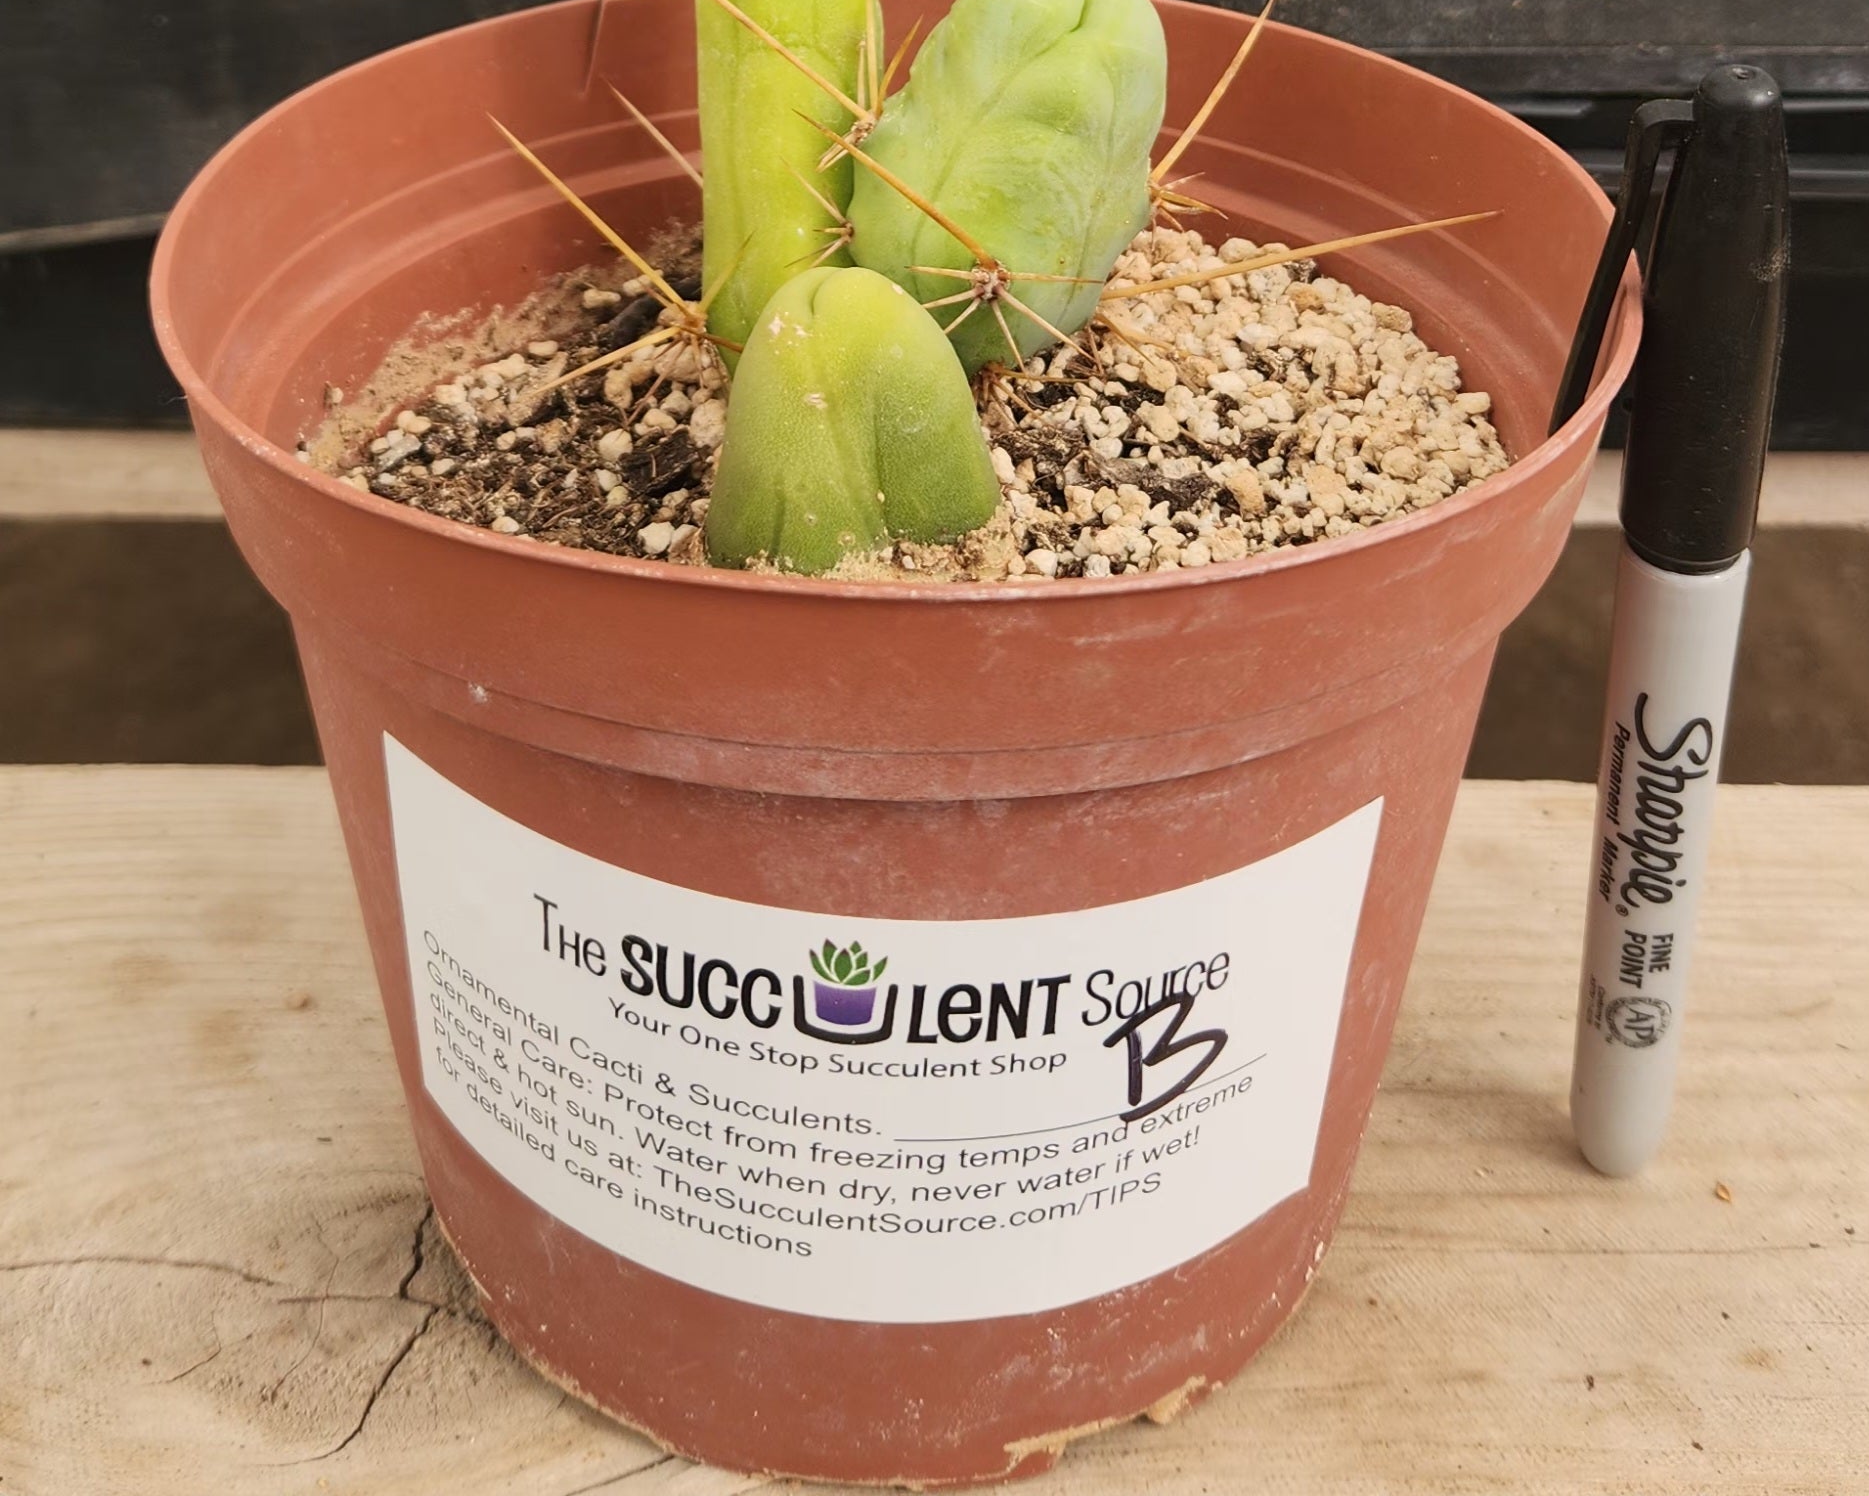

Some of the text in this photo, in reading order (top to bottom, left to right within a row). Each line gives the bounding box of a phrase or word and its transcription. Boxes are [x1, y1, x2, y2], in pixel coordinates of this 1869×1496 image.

[1598, 720, 1632, 903] Permanent Marker
[424, 930, 882, 1136] Ornamental Cacti & Succulents.
[608, 996, 1067, 1078] Your One Stop Succulent Shop
[1081, 951, 1230, 1027] Source
[1618, 929, 1648, 990] POINT
[1648, 932, 1675, 974] FINE
[427, 960, 1253, 1175] General Care: Protect from freezing temps and extreme
[430, 992, 1201, 1206] direct & hot sun. Water when dry, never water if wet!
[433, 1016, 1162, 1234] Please visit us at: TheSucculentSource.com/TIPS
[1103, 991, 1229, 1123] B
[436, 1045, 813, 1257] for detailed care instructions
